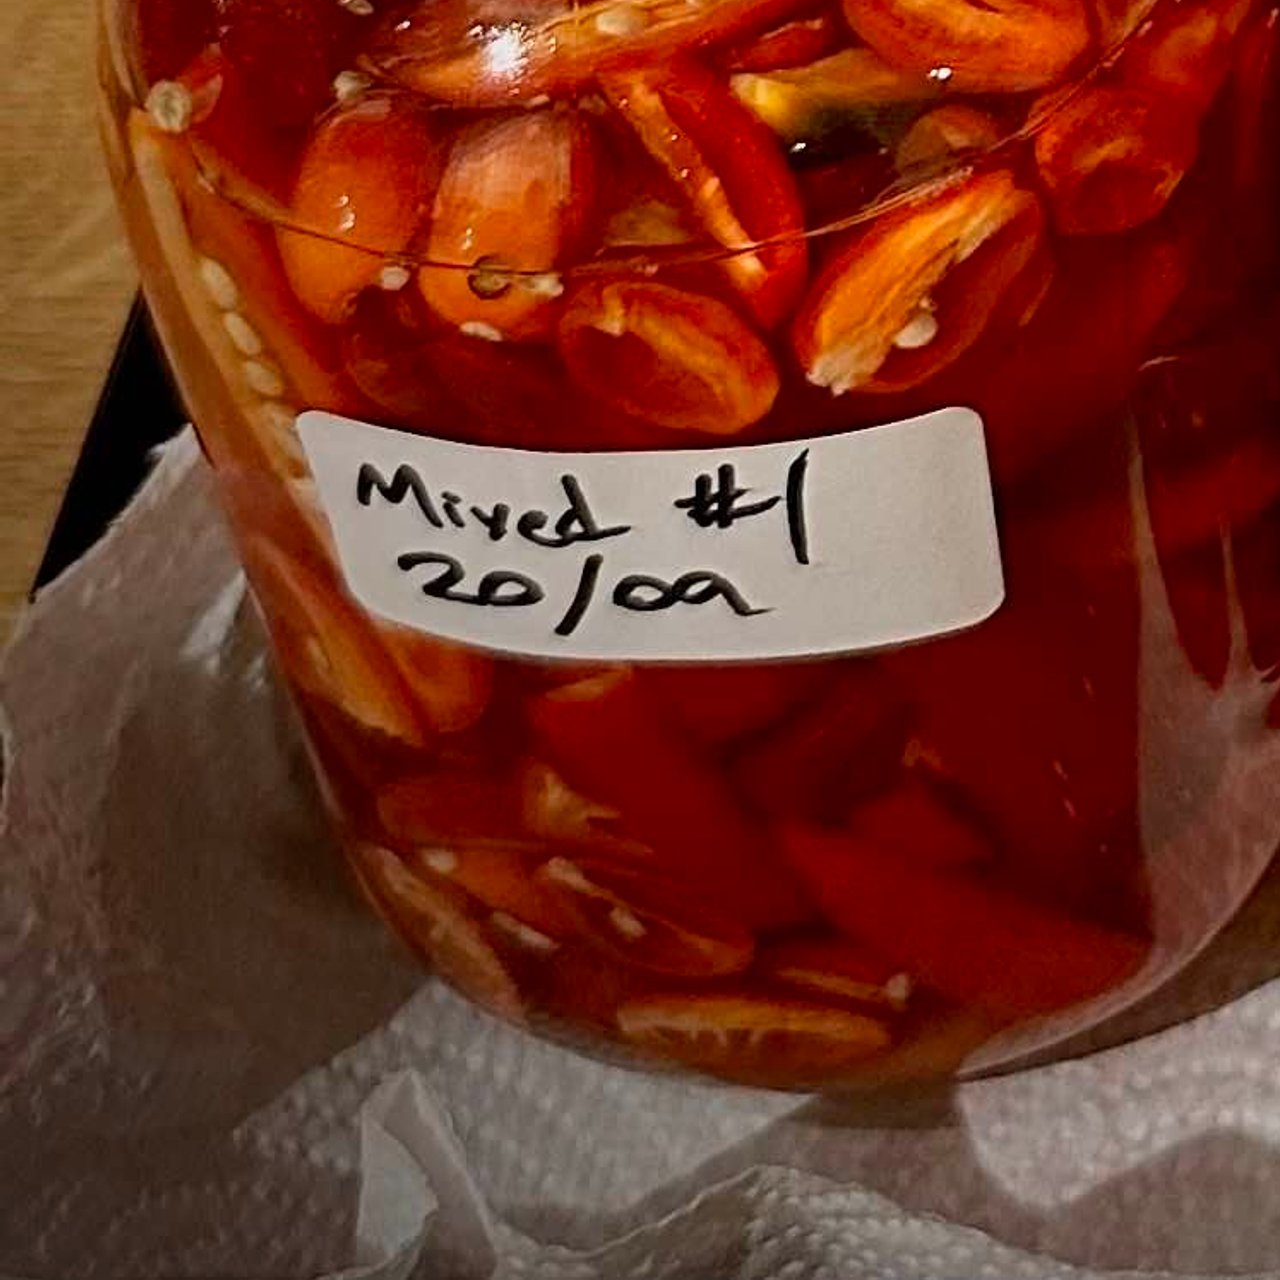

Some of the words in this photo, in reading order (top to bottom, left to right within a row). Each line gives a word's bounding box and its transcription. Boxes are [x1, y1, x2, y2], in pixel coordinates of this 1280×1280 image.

[357, 461, 631, 547] Mixed
[674, 447, 810, 566] #1
[398, 551, 776, 636] 20/09
